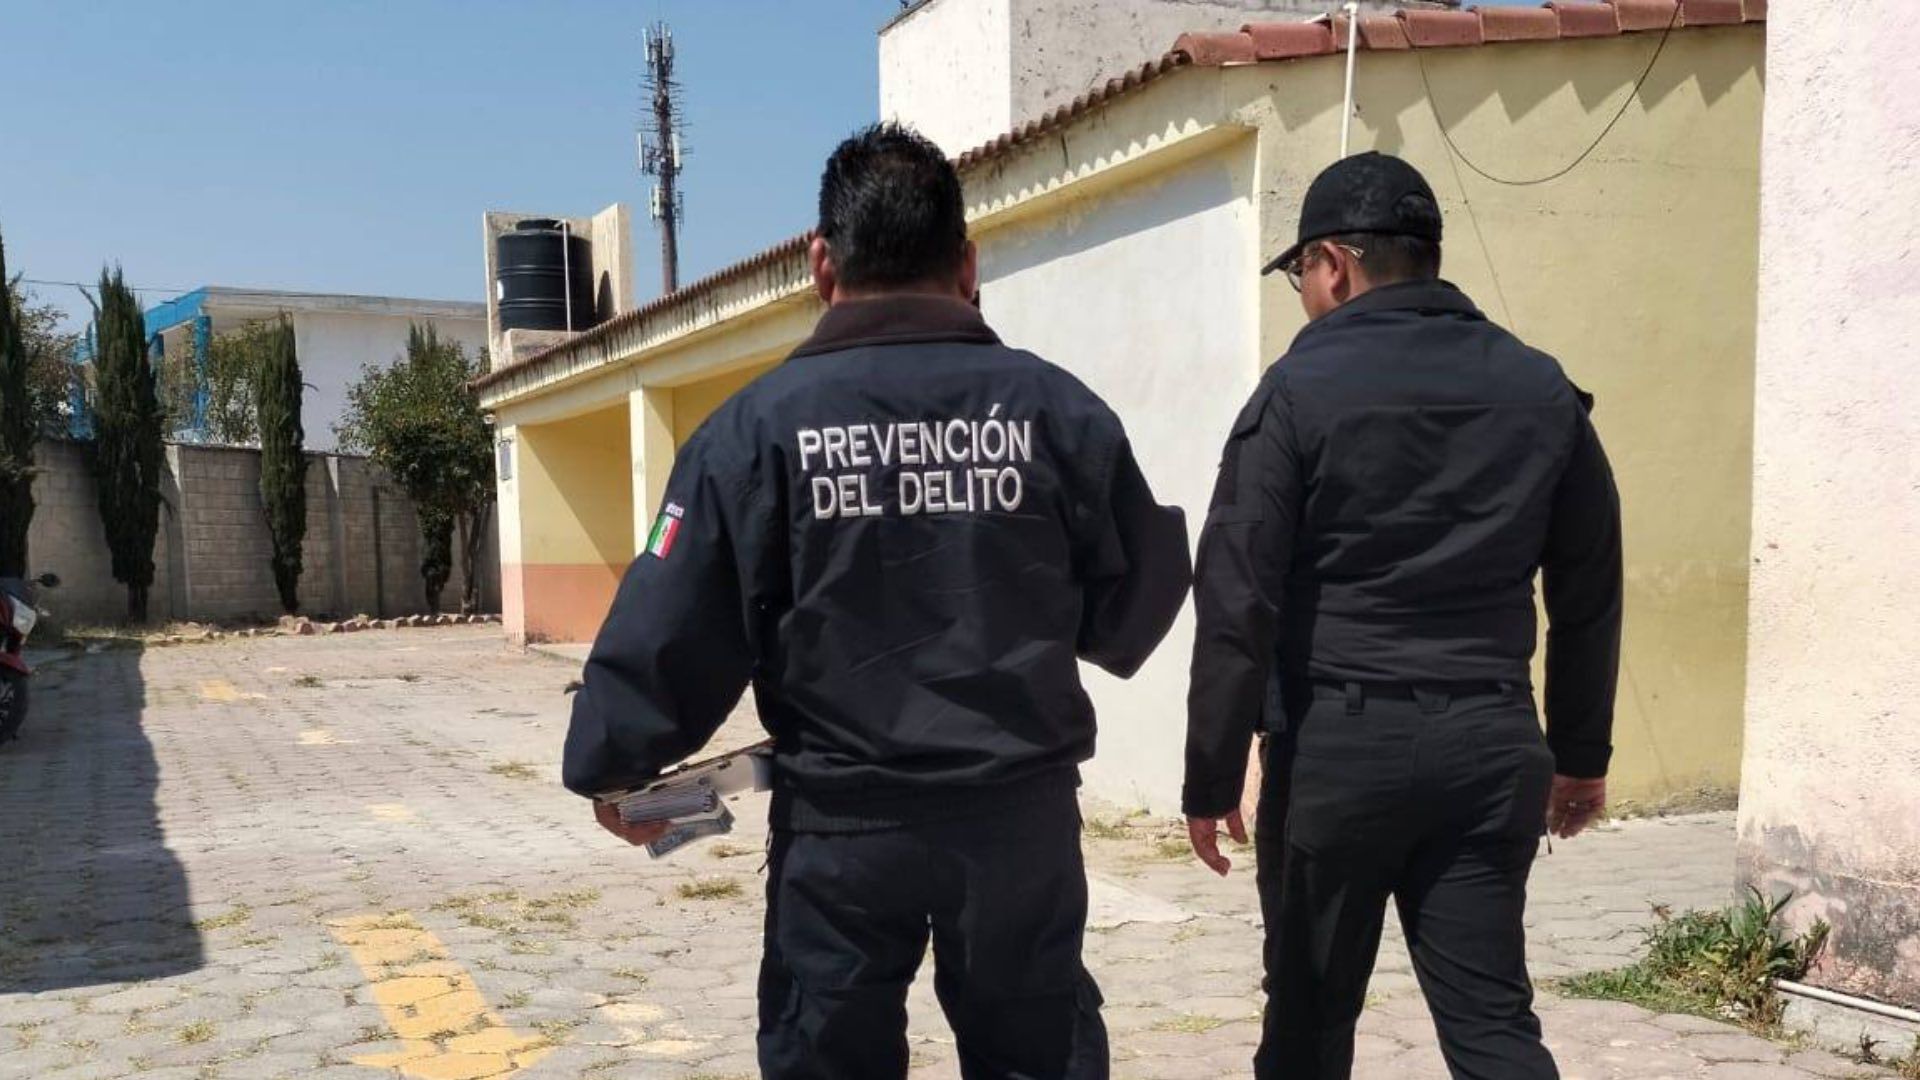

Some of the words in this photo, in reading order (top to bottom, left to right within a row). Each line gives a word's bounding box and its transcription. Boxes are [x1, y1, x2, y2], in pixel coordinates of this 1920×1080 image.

[797, 403, 1032, 471] PREVENCIÓN
[812, 474, 883, 519] DEL
[900, 466, 1022, 515] DELITO
